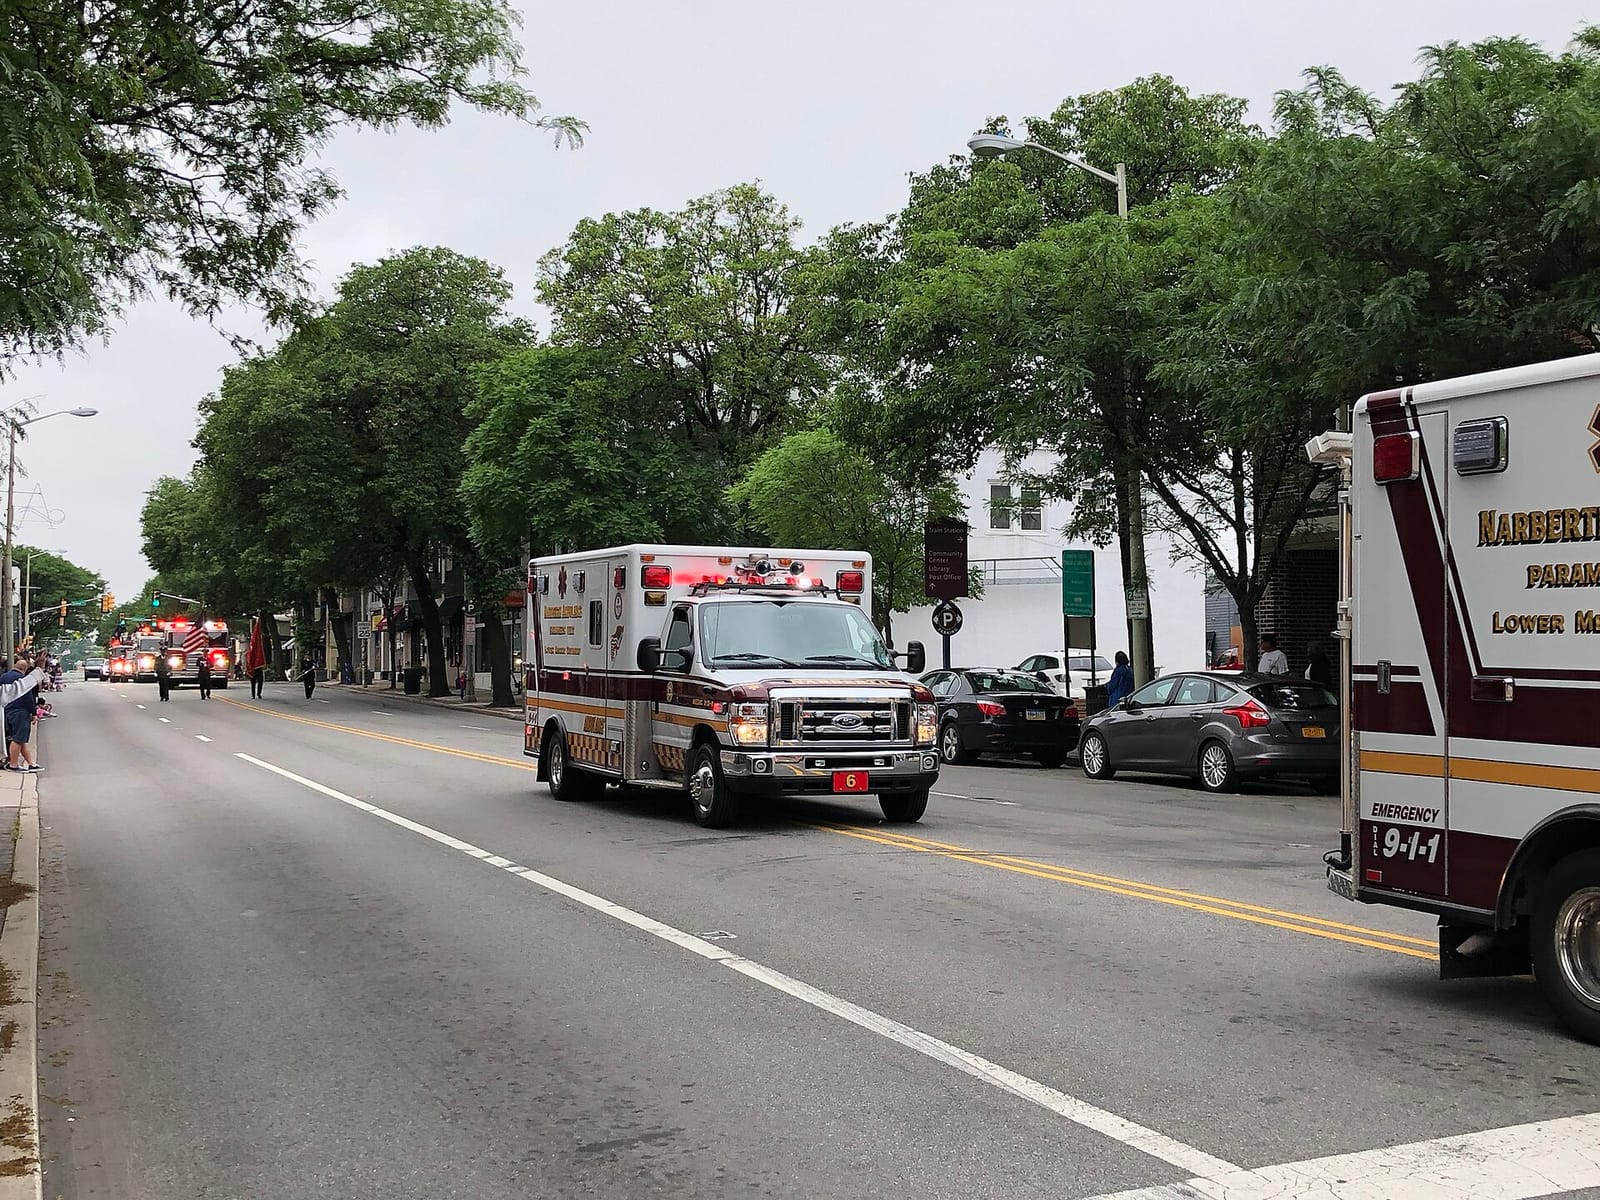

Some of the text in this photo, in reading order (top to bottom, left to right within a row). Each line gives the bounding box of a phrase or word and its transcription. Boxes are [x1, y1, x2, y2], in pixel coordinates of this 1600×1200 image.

[1477, 506, 1600, 547] NARBERT
[928, 550, 963, 558] Community
[928, 565, 950, 573] Library
[468, 604, 475, 612] P
[943, 612, 953, 627] P
[359, 630, 371, 638] 25
[846, 773, 856, 788] 6
[1371, 802, 1441, 824] EMERGENCY
[1382, 827, 1441, 864] 9-1-1
